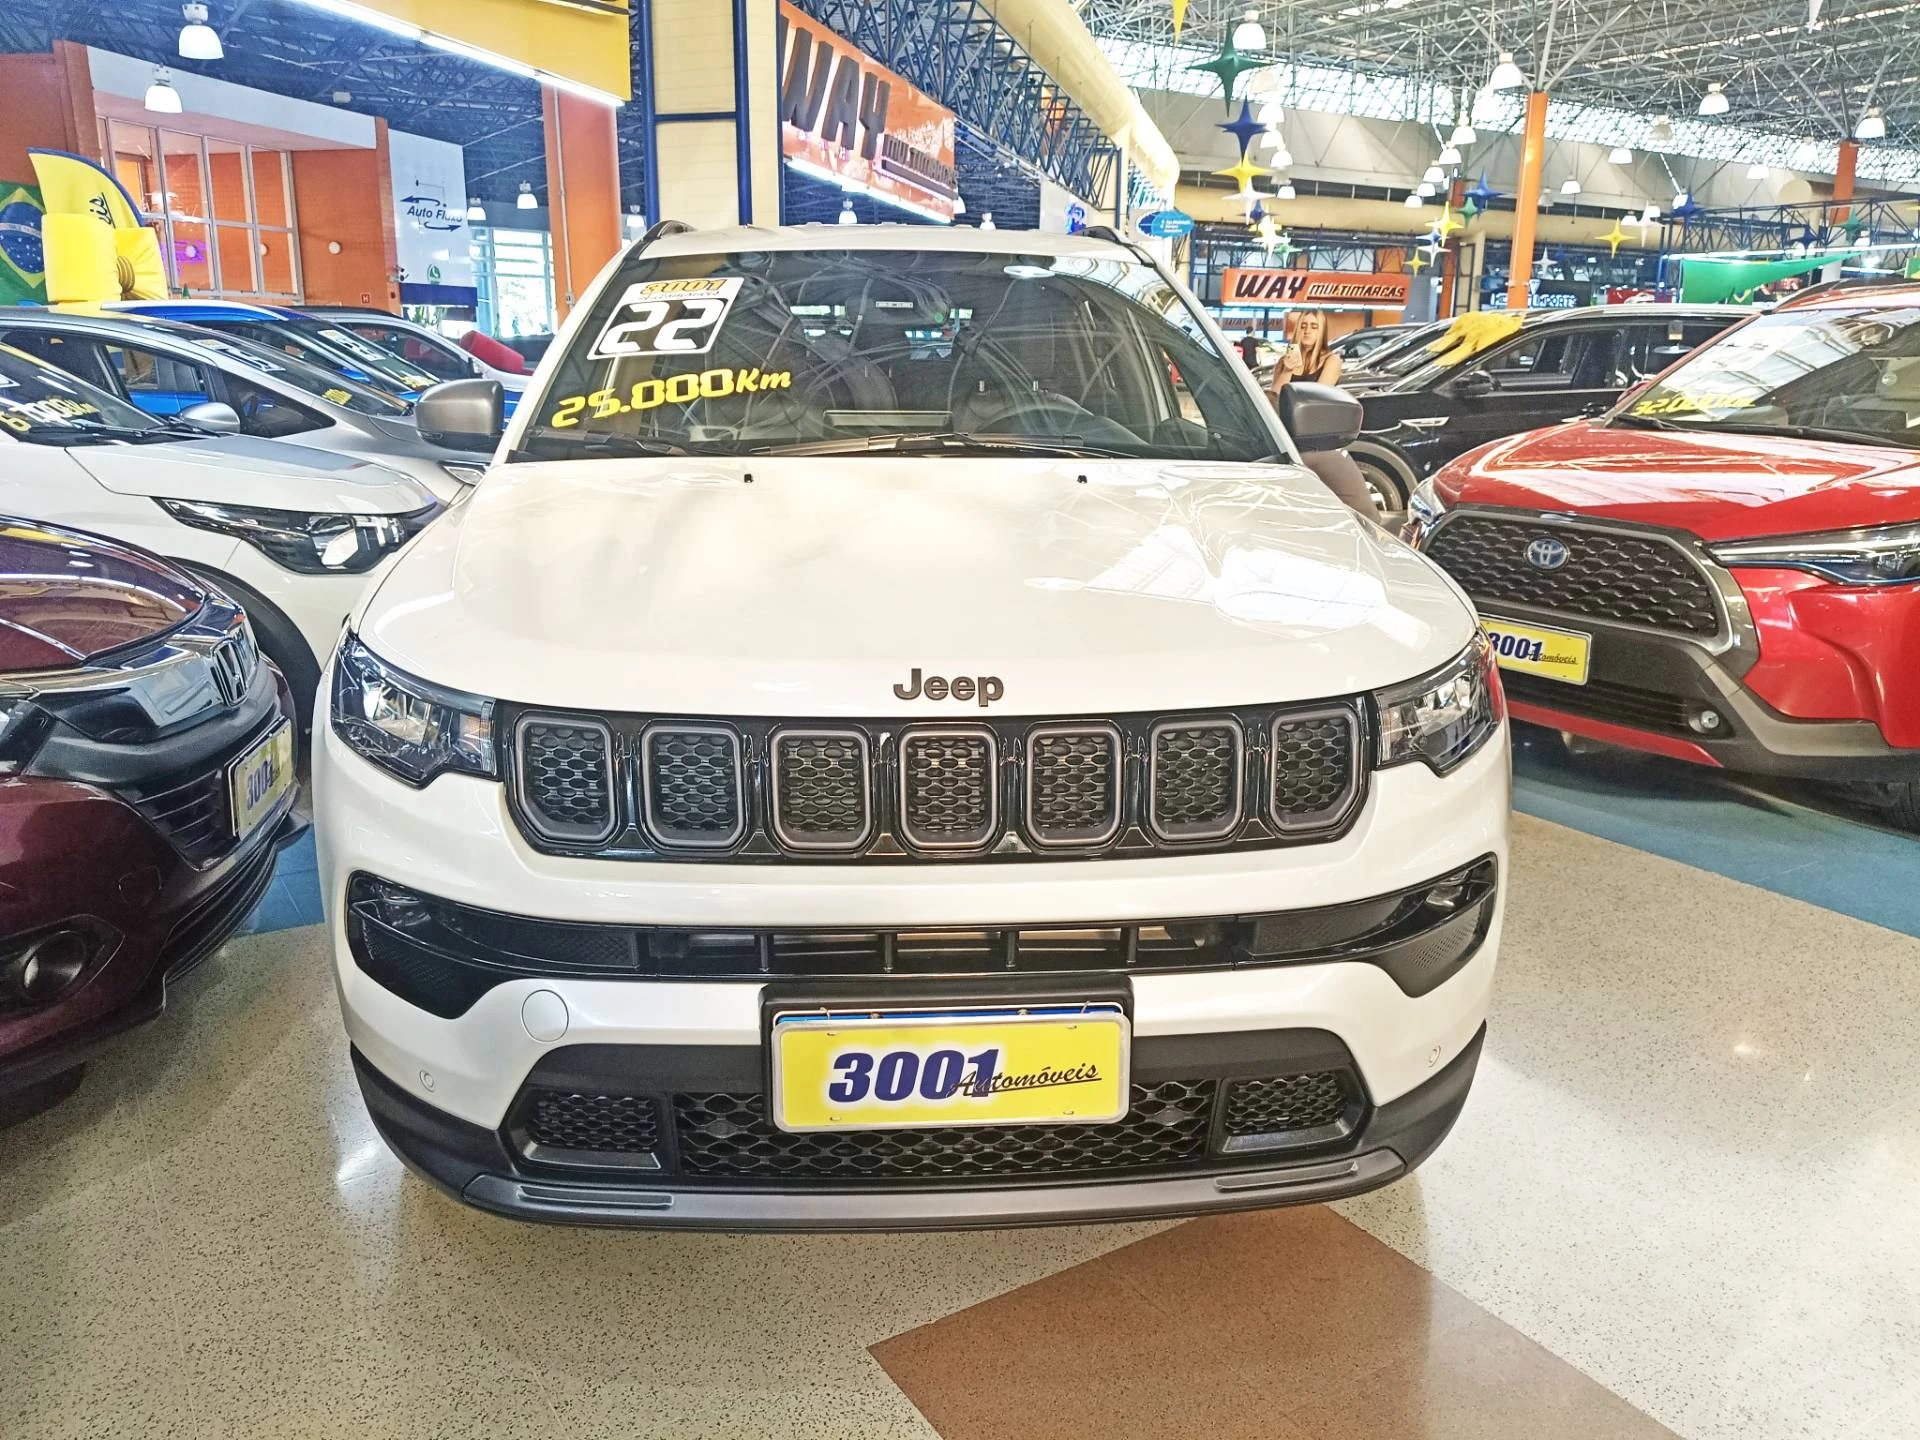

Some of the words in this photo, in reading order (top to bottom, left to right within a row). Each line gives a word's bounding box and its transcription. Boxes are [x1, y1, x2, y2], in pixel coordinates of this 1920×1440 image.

[780, 14, 890, 161] WAY
[407, 206, 432, 218] Auto
[640, 279, 728, 294] 3001
[1235, 274, 1307, 299] WAY
[1309, 282, 1405, 298] MULTIMARCAS
[598, 298, 725, 353] 22
[1488, 632, 1543, 662] 3001
[893, 668, 1004, 707] Jeep
[828, 1049, 999, 1103] 3001
[946, 1062, 1102, 1097] Automóveis
